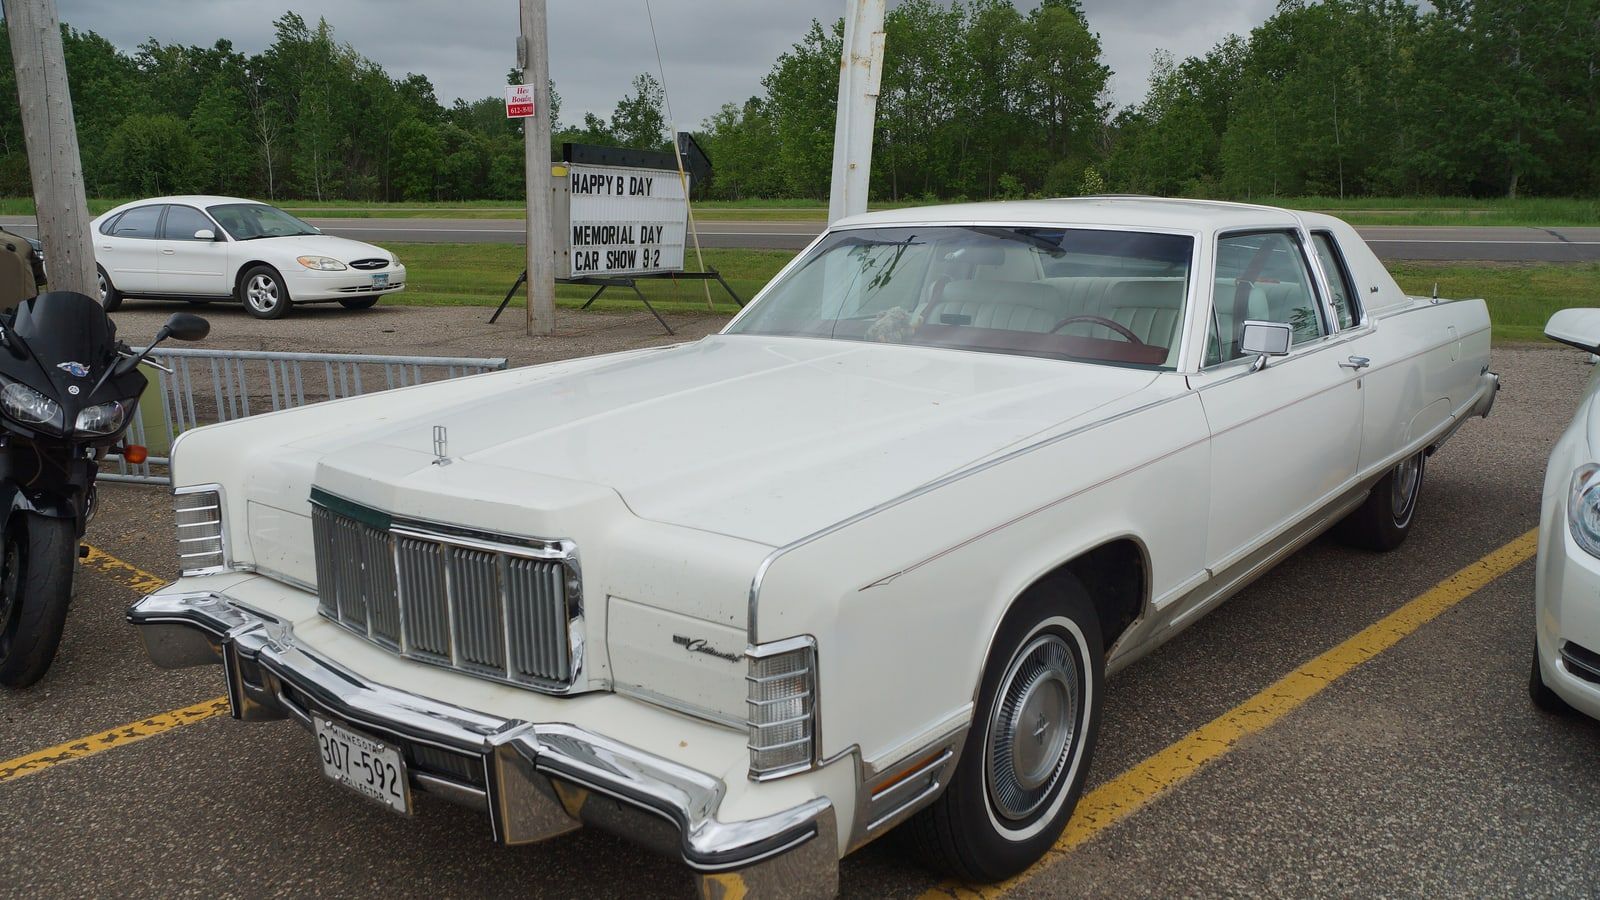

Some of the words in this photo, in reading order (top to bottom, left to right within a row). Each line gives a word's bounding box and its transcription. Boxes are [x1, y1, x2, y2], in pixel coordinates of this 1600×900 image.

[572, 173, 613, 195] HAPPY
[616, 176, 624, 195] B
[629, 176, 653, 196] DAY
[573, 225, 635, 246] MEMORIAL
[640, 225, 663, 244] DAY
[575, 250, 599, 271] CAR
[606, 249, 637, 270] SHOW
[319, 733, 401, 798] 307-592
